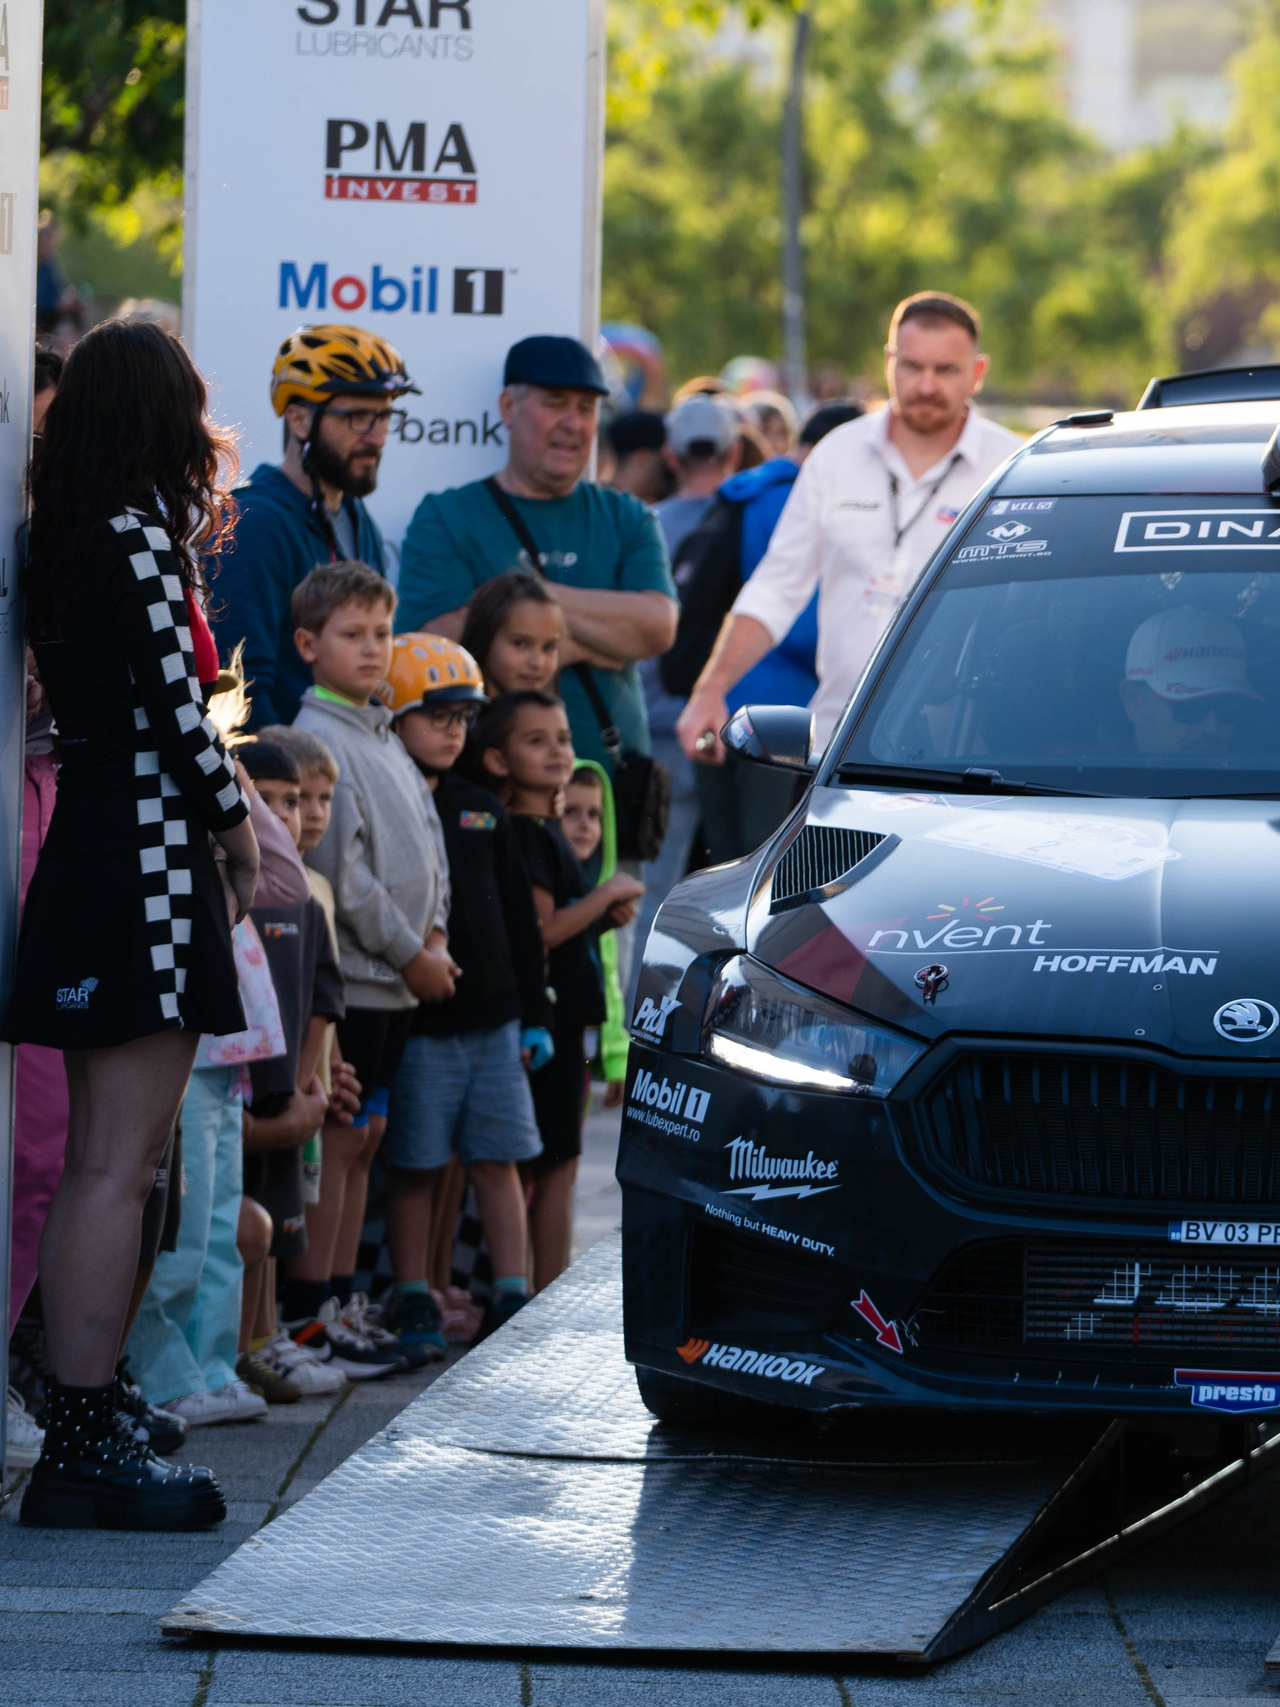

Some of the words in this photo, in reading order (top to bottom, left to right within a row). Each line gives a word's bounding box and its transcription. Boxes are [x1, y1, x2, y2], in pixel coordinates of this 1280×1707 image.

[295, 29, 474, 62] LUBRICANTS
[325, 118, 477, 175] PMA
[278, 260, 438, 314] Mobil
[1033, 954, 1218, 976] HOFFMAN
[56, 987, 89, 1003] STAR
[631, 1068, 687, 1115] Mobil
[626, 1105, 701, 1142] www.lubexpert.ro
[705, 1203, 742, 1227] Nothing
[744, 1216, 760, 1231] but
[761, 1223, 800, 1245] HEAVY
[1185, 1222, 1218, 1241] BV
[1224, 1223, 1249, 1242] 03
[1198, 1384, 1276, 1402] presto
